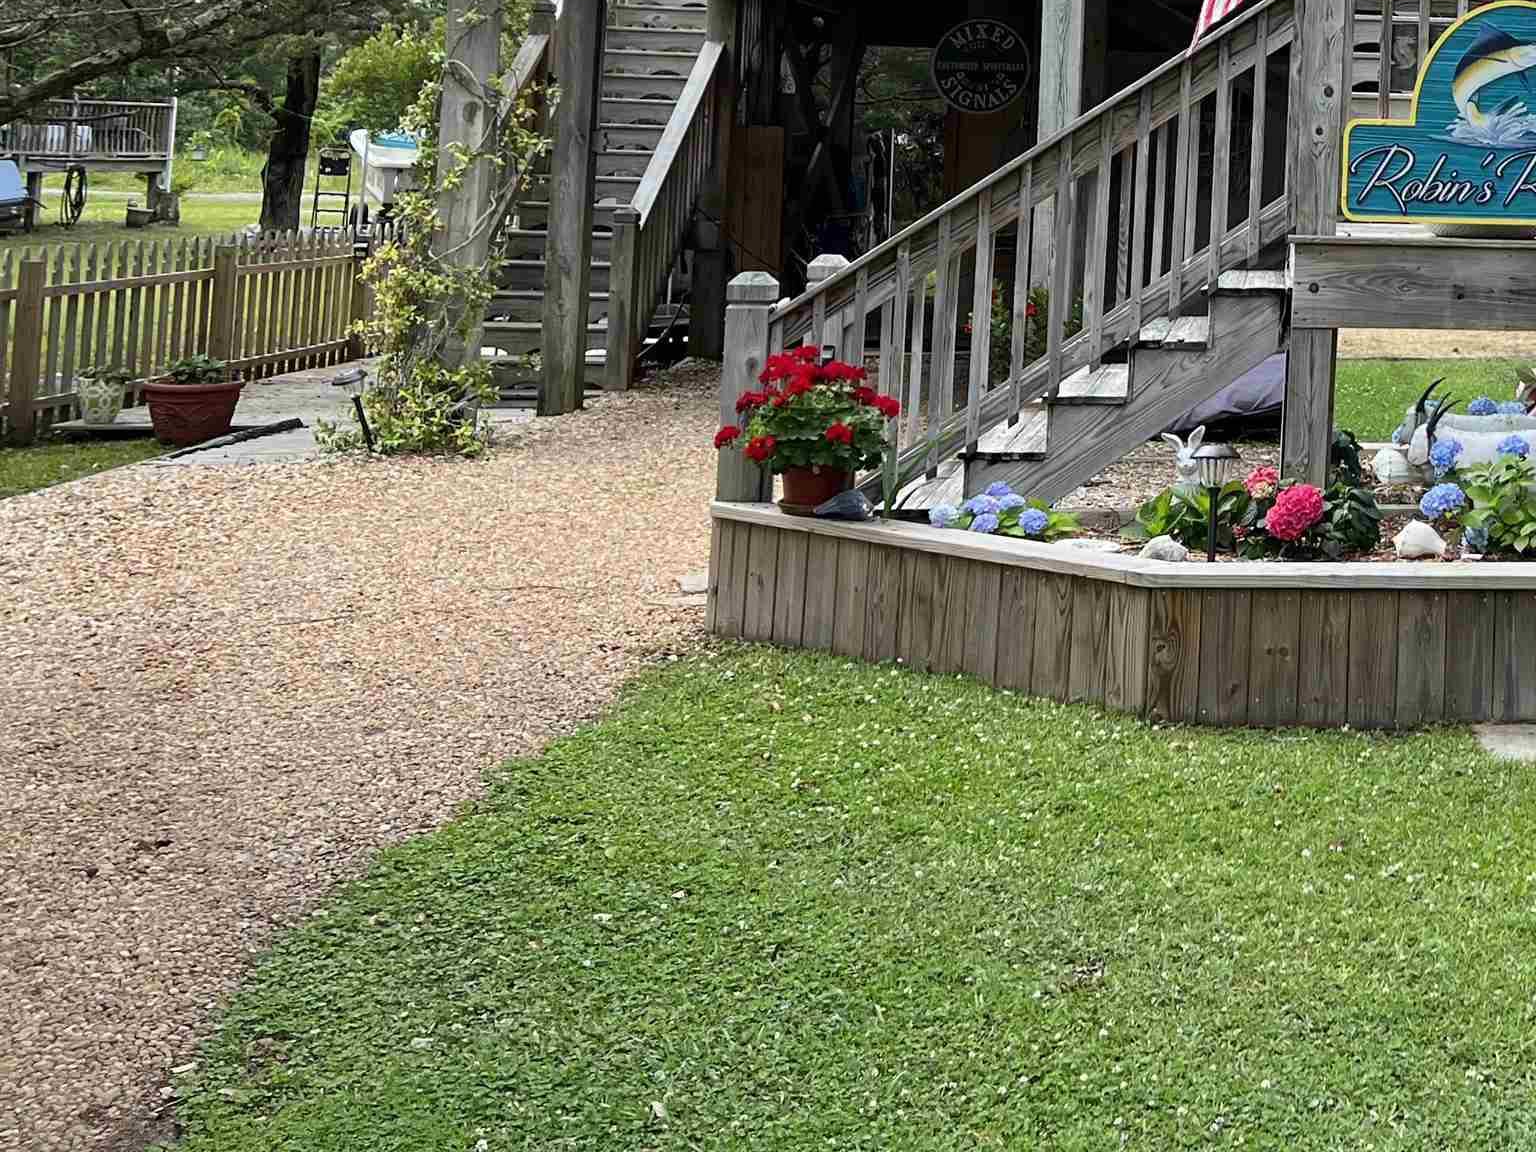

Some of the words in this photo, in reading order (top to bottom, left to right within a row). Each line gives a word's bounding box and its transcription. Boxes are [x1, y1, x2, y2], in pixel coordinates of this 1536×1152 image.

[949, 24, 1016, 49] MIXED
[940, 76, 1017, 109] SIGNALS
[1350, 144, 1495, 215] Robin's
